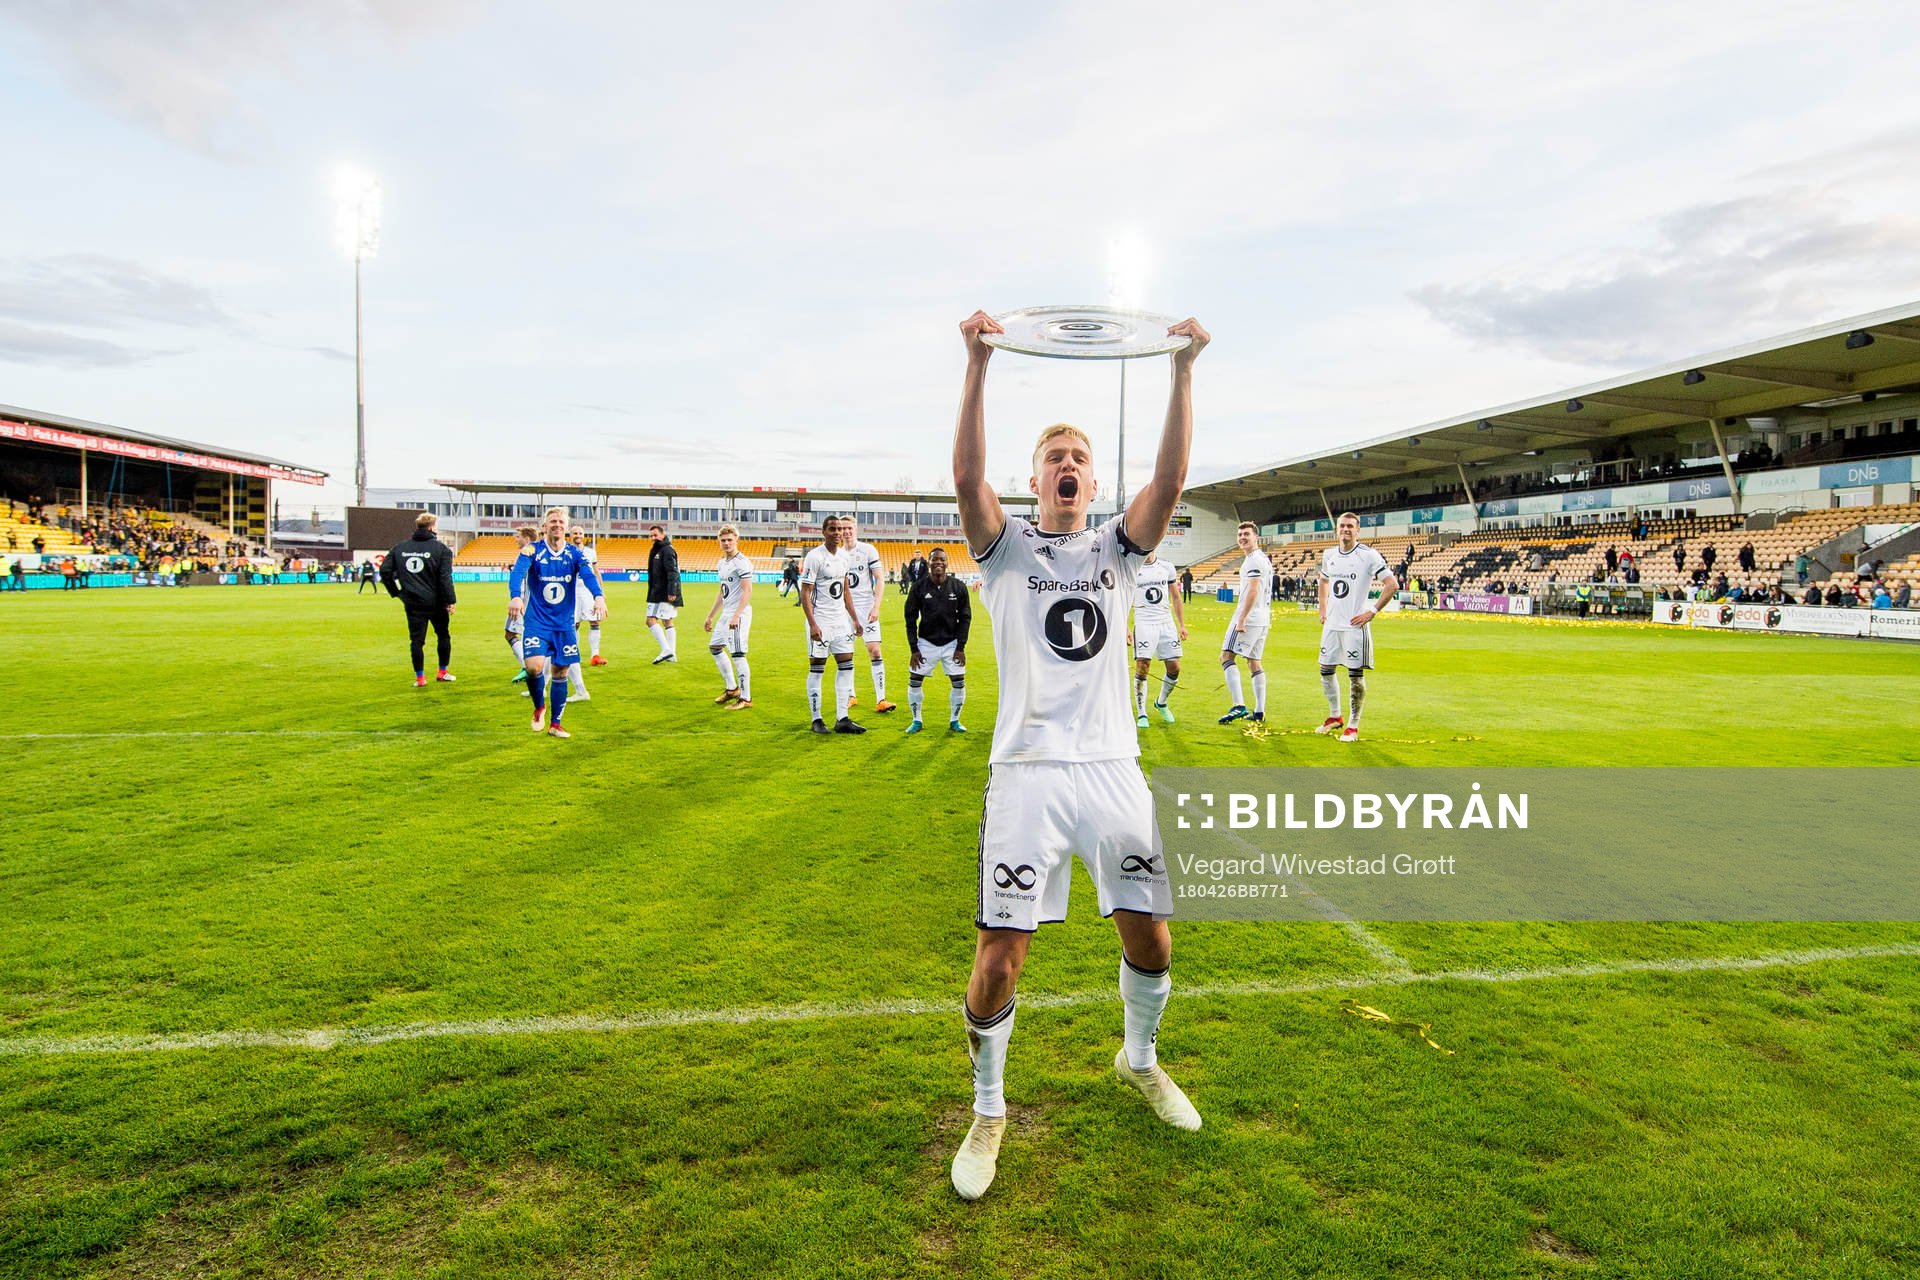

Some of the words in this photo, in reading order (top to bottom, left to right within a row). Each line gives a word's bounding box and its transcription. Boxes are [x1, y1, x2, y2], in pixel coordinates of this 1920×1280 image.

[1848, 464, 1879, 486] DNB
[1689, 480, 1712, 499] DNB
[1492, 501, 1506, 516] DNB
[1577, 493, 1594, 509] DNB
[1421, 511, 1433, 523] DNB
[1028, 576, 1101, 593] SpareBank
[1735, 607, 1760, 621] eda
